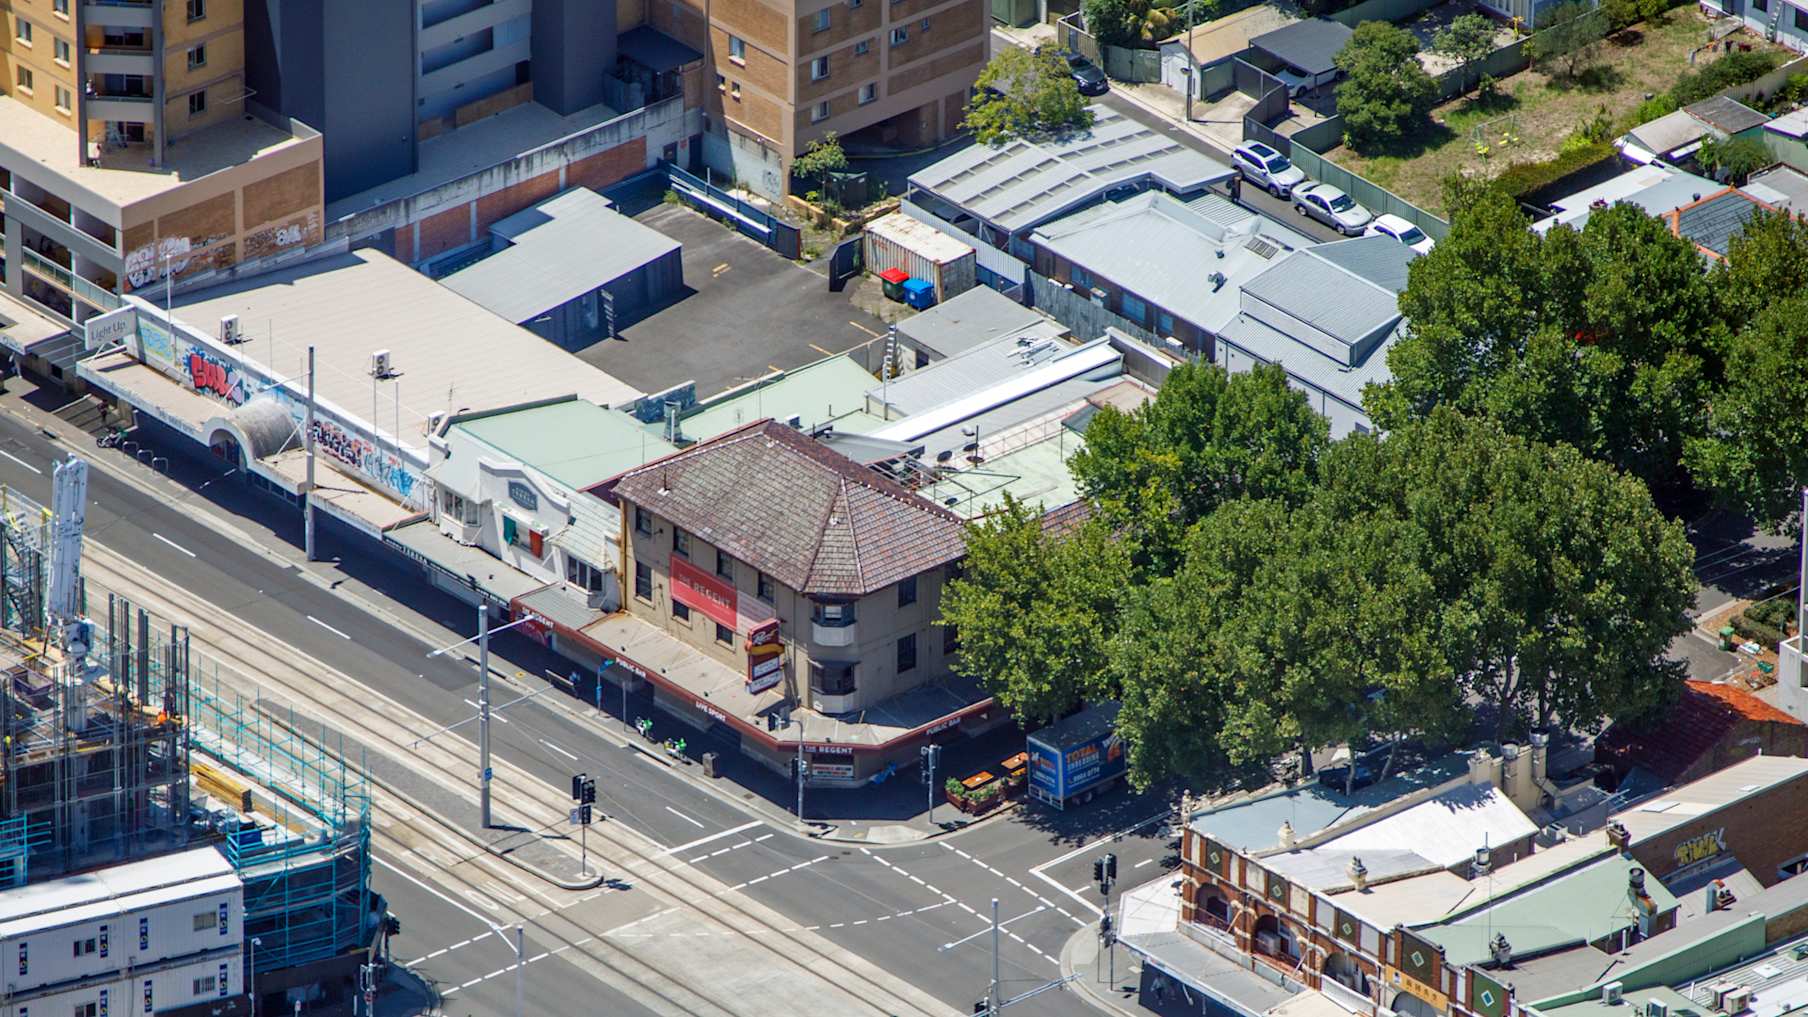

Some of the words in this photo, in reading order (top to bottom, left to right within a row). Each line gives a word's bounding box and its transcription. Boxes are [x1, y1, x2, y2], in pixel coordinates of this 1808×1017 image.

[91, 326, 111, 342] Light
[112, 321, 126, 335] Up
[694, 582, 732, 609] REGENT
[926, 723, 948, 736] PUBLIC
[949, 716, 961, 728] BAR
[818, 745, 853, 755] REGENT
[1066, 743, 1099, 764] TOTAL
